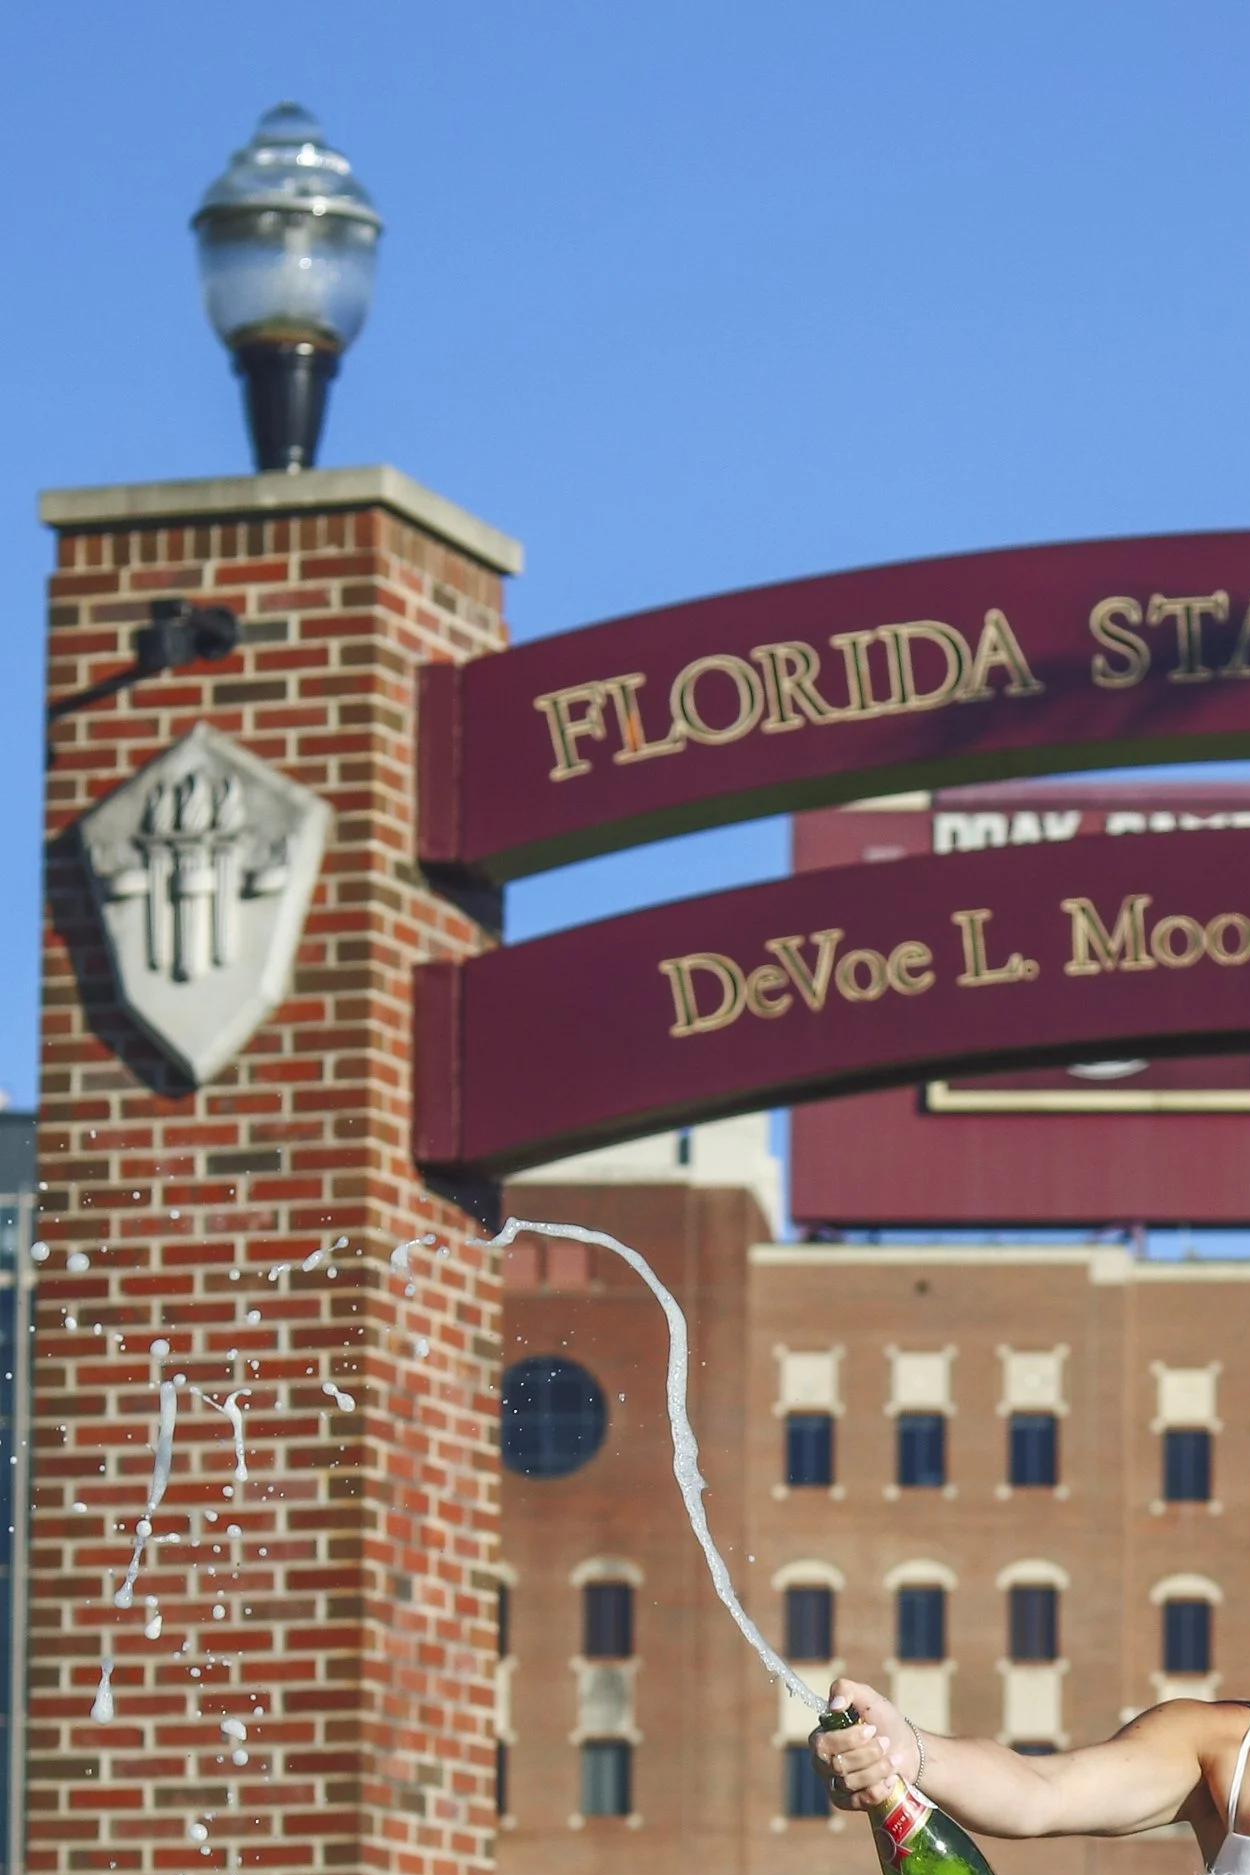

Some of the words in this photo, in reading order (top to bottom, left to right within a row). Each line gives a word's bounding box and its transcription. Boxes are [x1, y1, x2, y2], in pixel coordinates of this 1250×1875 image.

[534, 608, 1044, 782] FLORIDA
[658, 928, 935, 1037] DeVoe
[951, 908, 1040, 987] L.
